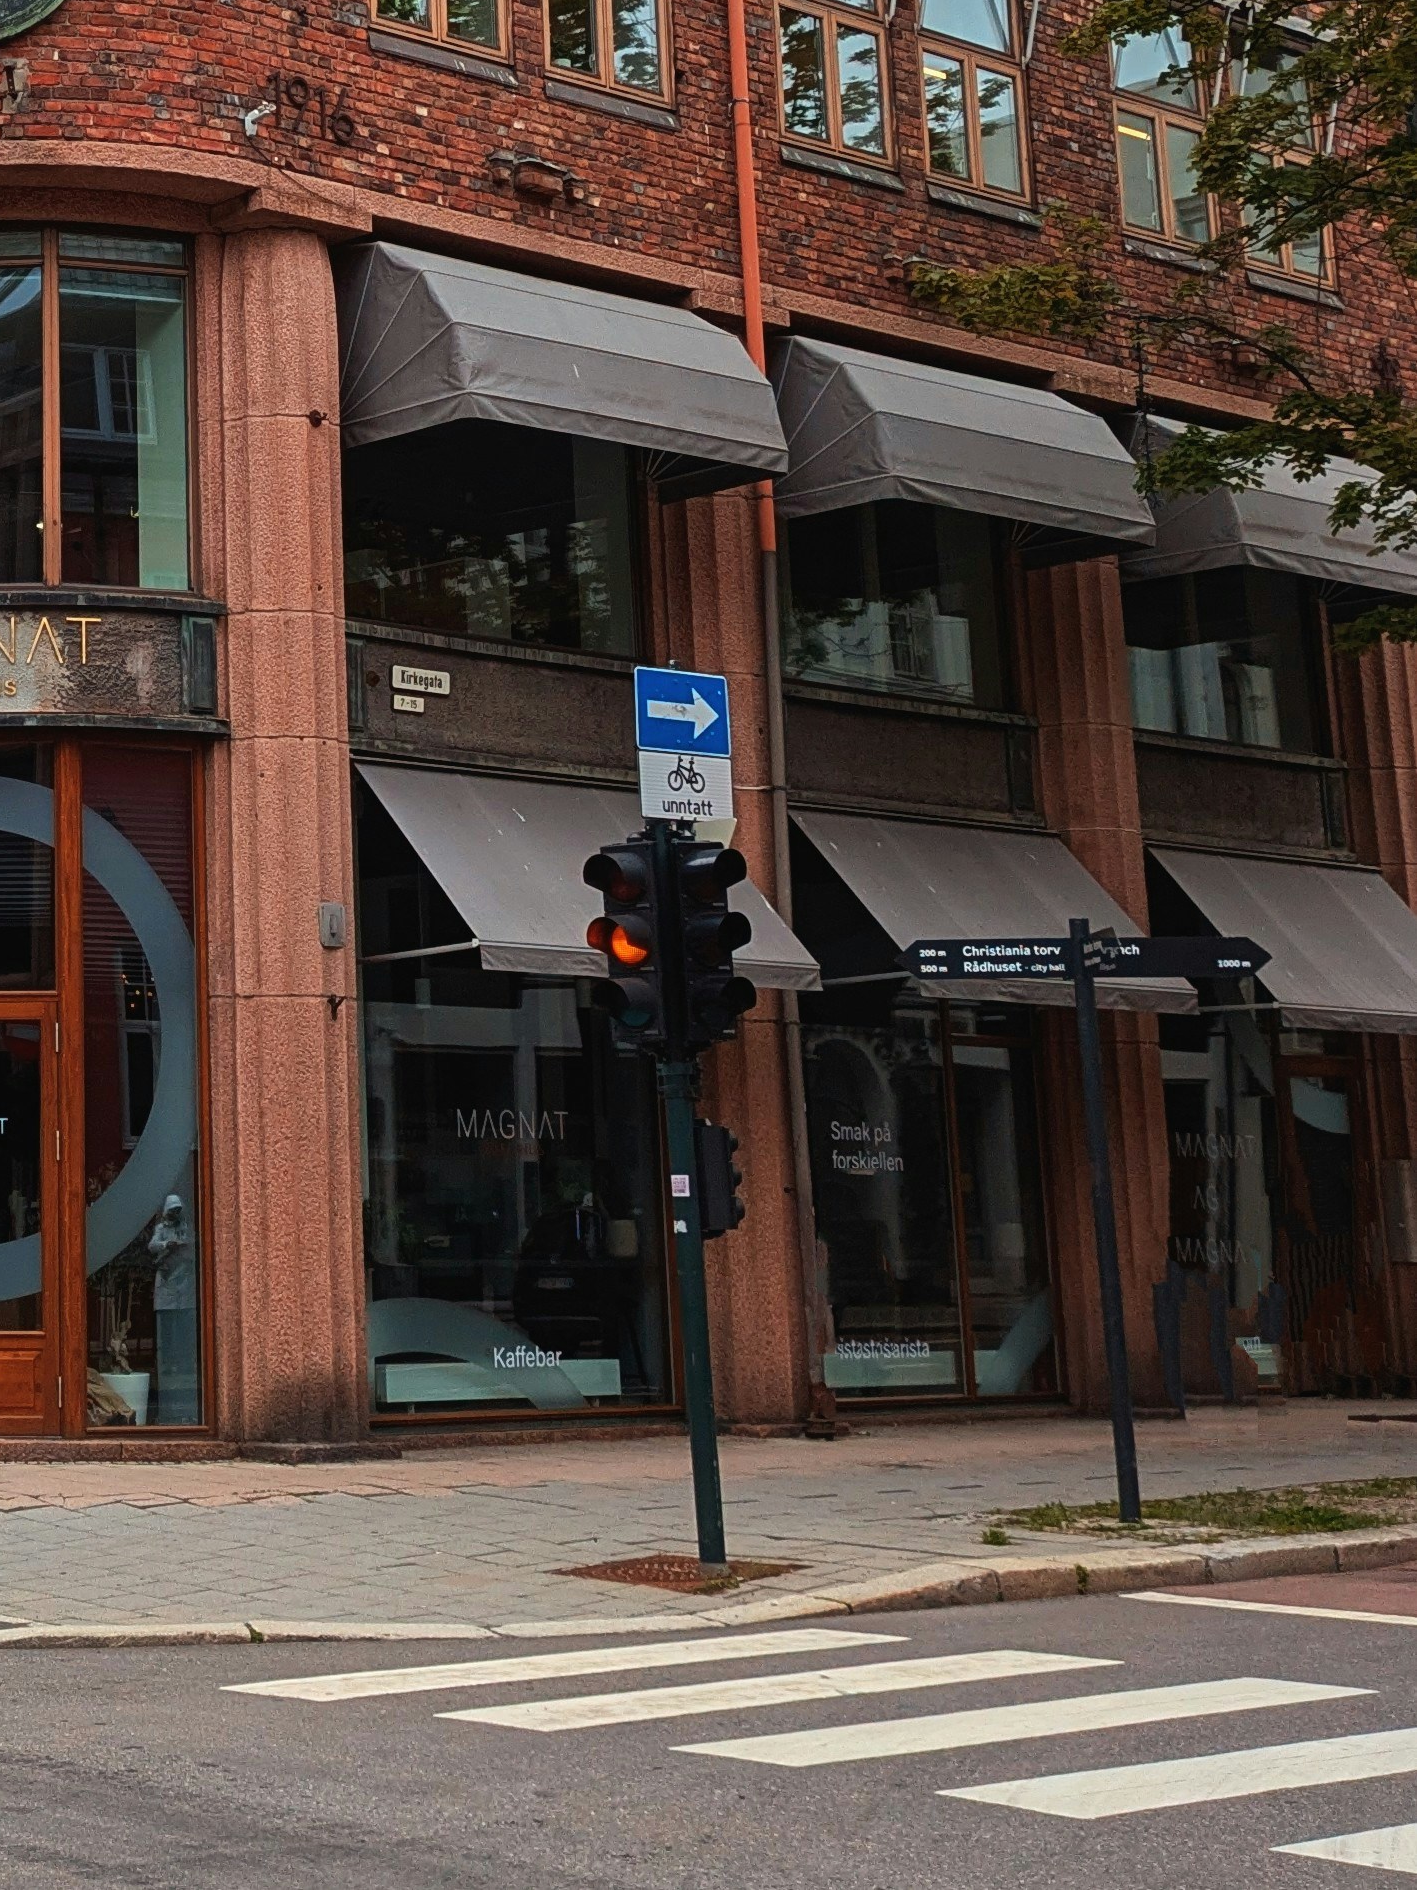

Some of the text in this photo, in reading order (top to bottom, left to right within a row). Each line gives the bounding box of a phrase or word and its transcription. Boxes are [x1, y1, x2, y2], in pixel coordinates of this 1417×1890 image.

[267, 71, 355, 146] 1916
[400, 670, 443, 690] Kirkegata
[662, 799, 713, 816] unntatt
[919, 949, 936, 957] 200
[962, 945, 1031, 956] Christiania
[1034, 946, 1061, 956] torv
[920, 965, 937, 973] 500
[964, 961, 1022, 973] Rådhuset
[1031, 964, 1047, 973] city
[1049, 964, 1065, 972] hall
[1217, 960, 1240, 968] 1000
[456, 1109, 568, 1140] MAGNAT
[831, 1121, 891, 1146] Smak på
[493, 1345, 563, 1368] Kaffebar
